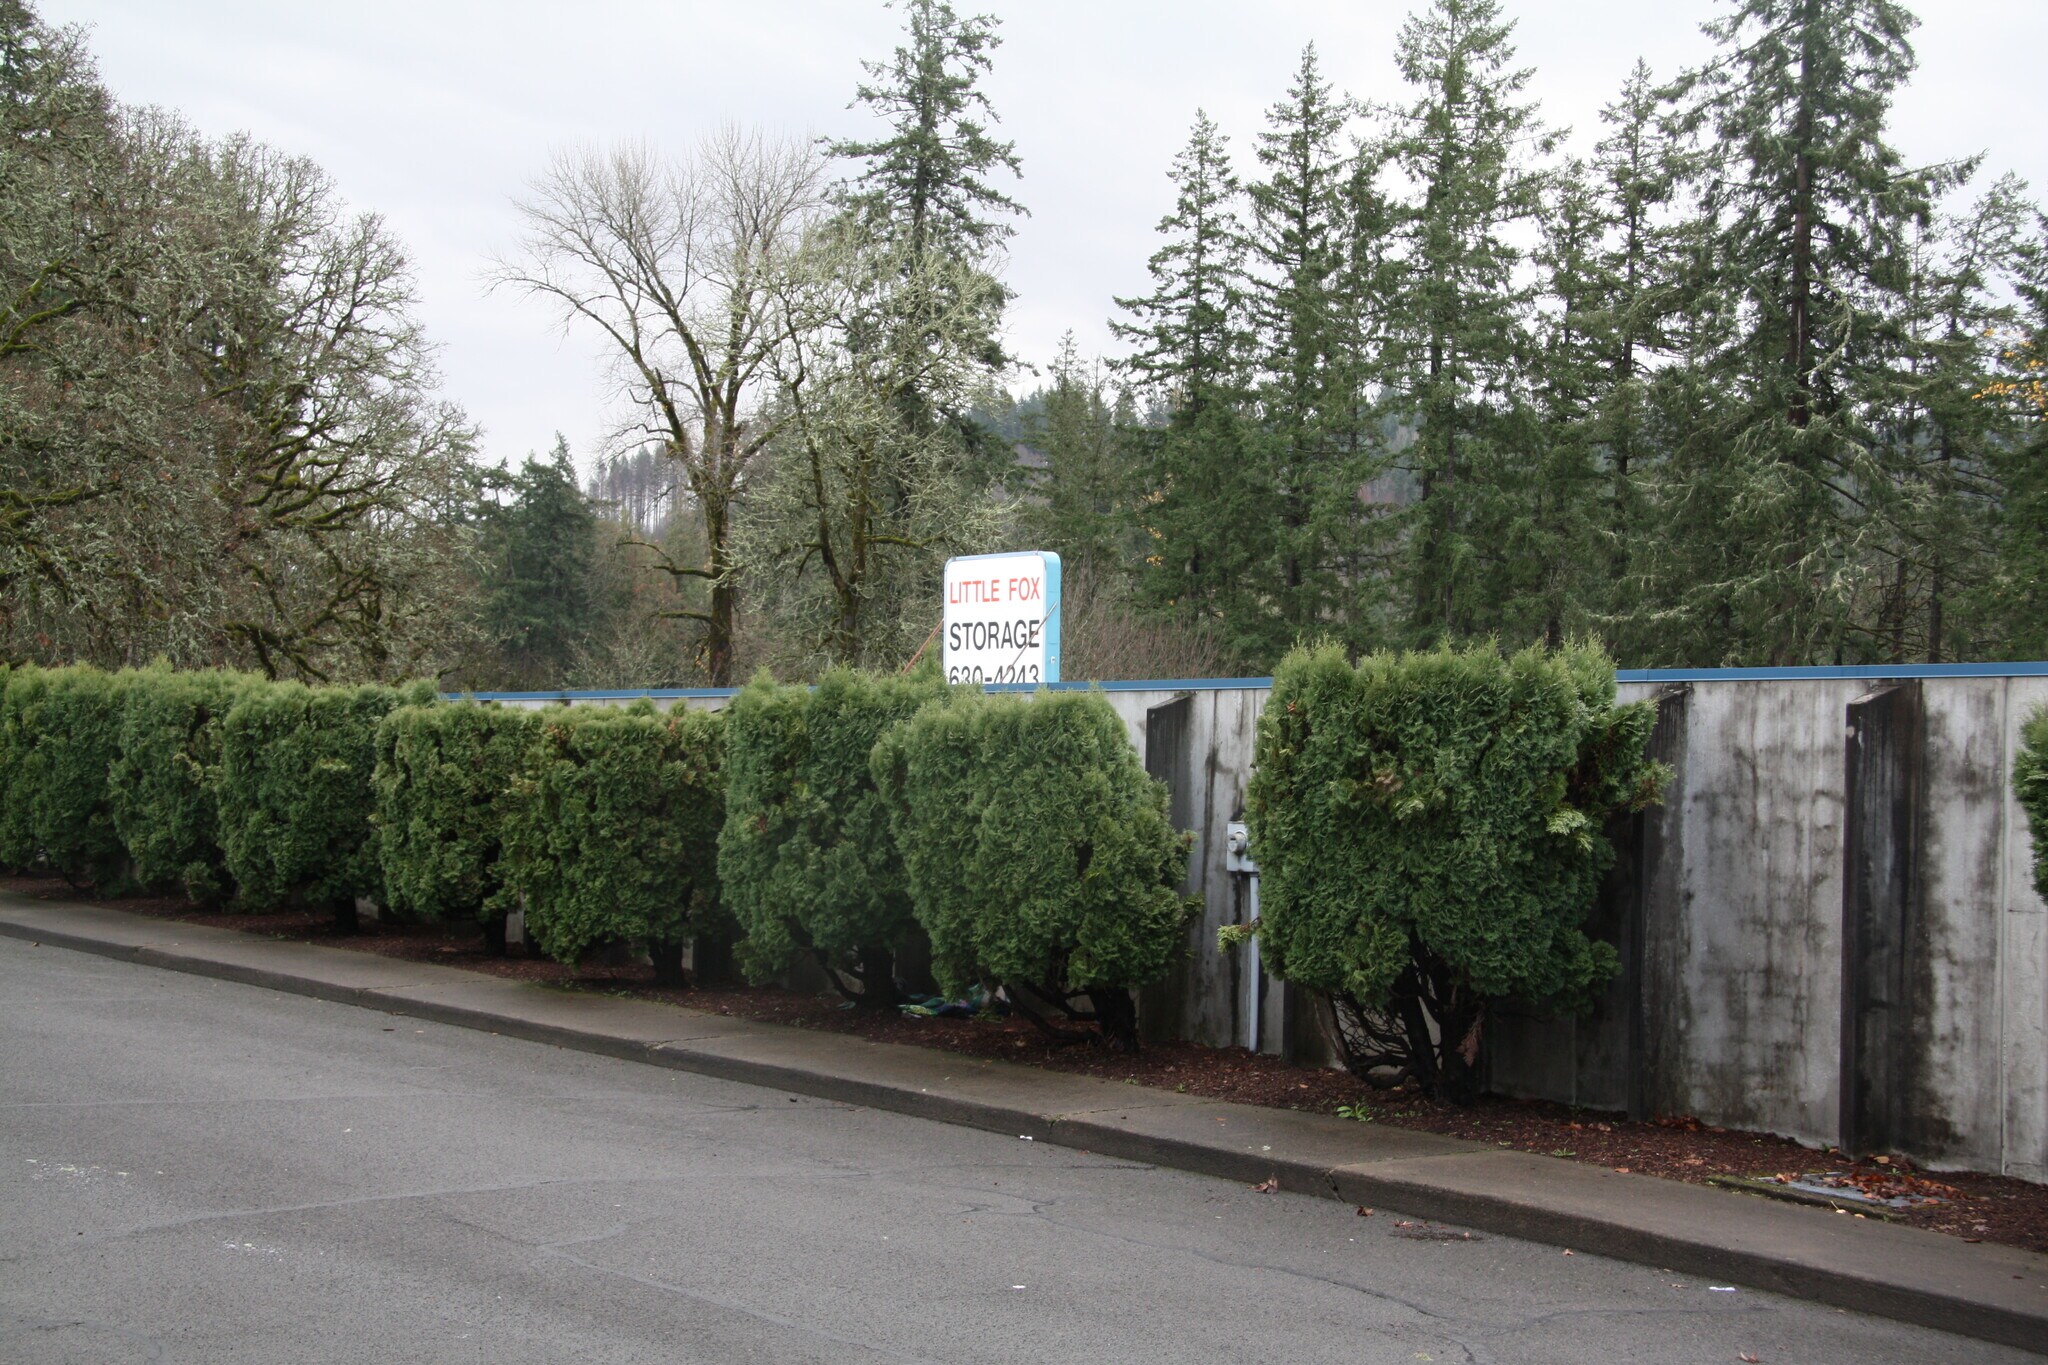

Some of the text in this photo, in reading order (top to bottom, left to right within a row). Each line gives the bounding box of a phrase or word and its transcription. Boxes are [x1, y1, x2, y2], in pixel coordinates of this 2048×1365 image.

[950, 577, 1040, 603] LITTLE FOX
[949, 619, 1040, 651] STORAGE
